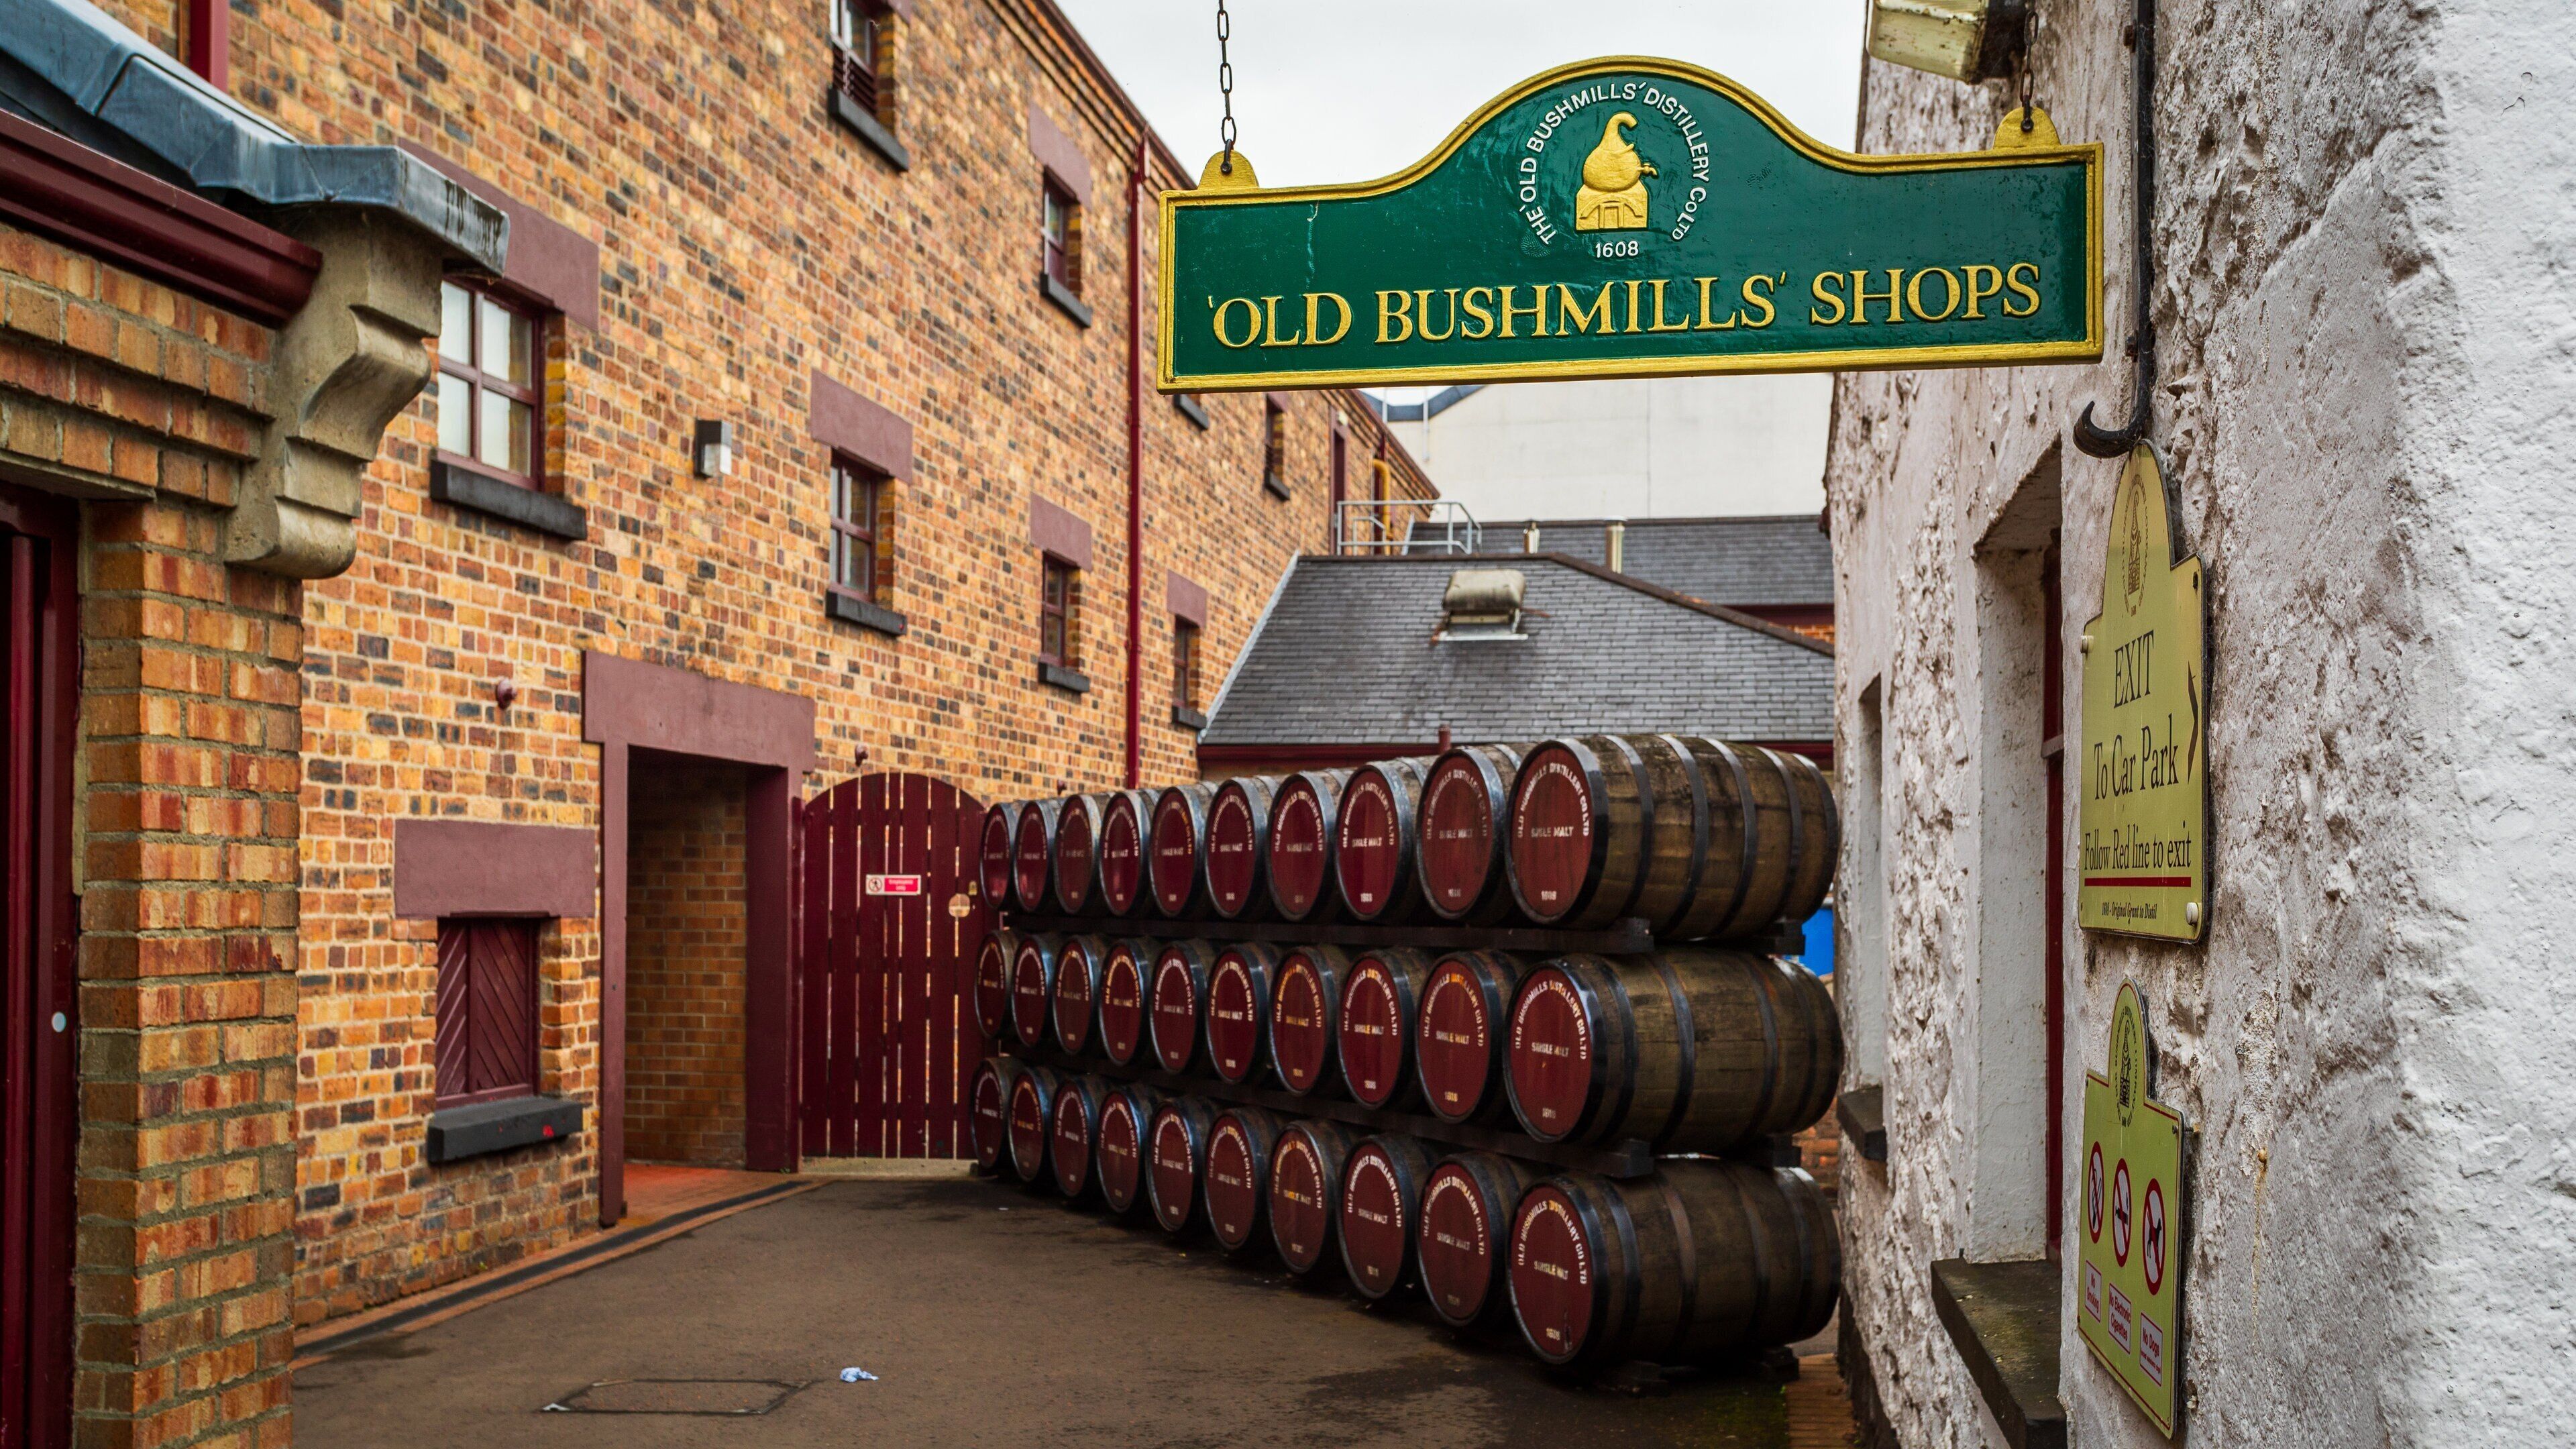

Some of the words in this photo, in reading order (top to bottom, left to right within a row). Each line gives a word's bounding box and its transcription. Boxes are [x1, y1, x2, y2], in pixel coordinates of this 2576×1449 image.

[1525, 205, 1556, 246] THE
[1643, 87, 1710, 183] DISTILLERY
[1595, 240, 1640, 258] 1608
[1374, 271, 1786, 343] BUSHMILLS'
[1811, 262, 2040, 326] SHOPS
[2114, 629, 2154, 709] EXIT
[2094, 741, 2108, 800] To
[2112, 734, 2136, 798] Car
[2139, 712, 2179, 791] Park
[1553, 826, 1574, 837] MALT
[2084, 828, 2110, 871] Follow
[2112, 824, 2131, 869] Red
[2132, 823, 2150, 869] line
[2153, 833, 2163, 869] to
[2167, 820, 2192, 868] exit
[2111, 902, 2126, 920] Original
[2127, 902, 2139, 920] Grant
[2139, 904, 2144, 918] to
[2144, 903, 2157, 920] Distil
[2108, 1291, 2114, 1307] No
[2114, 1297, 2131, 1324] Electronic
[2143, 1327, 2149, 1346] No
[2149, 1333, 2159, 1358] Dogs
